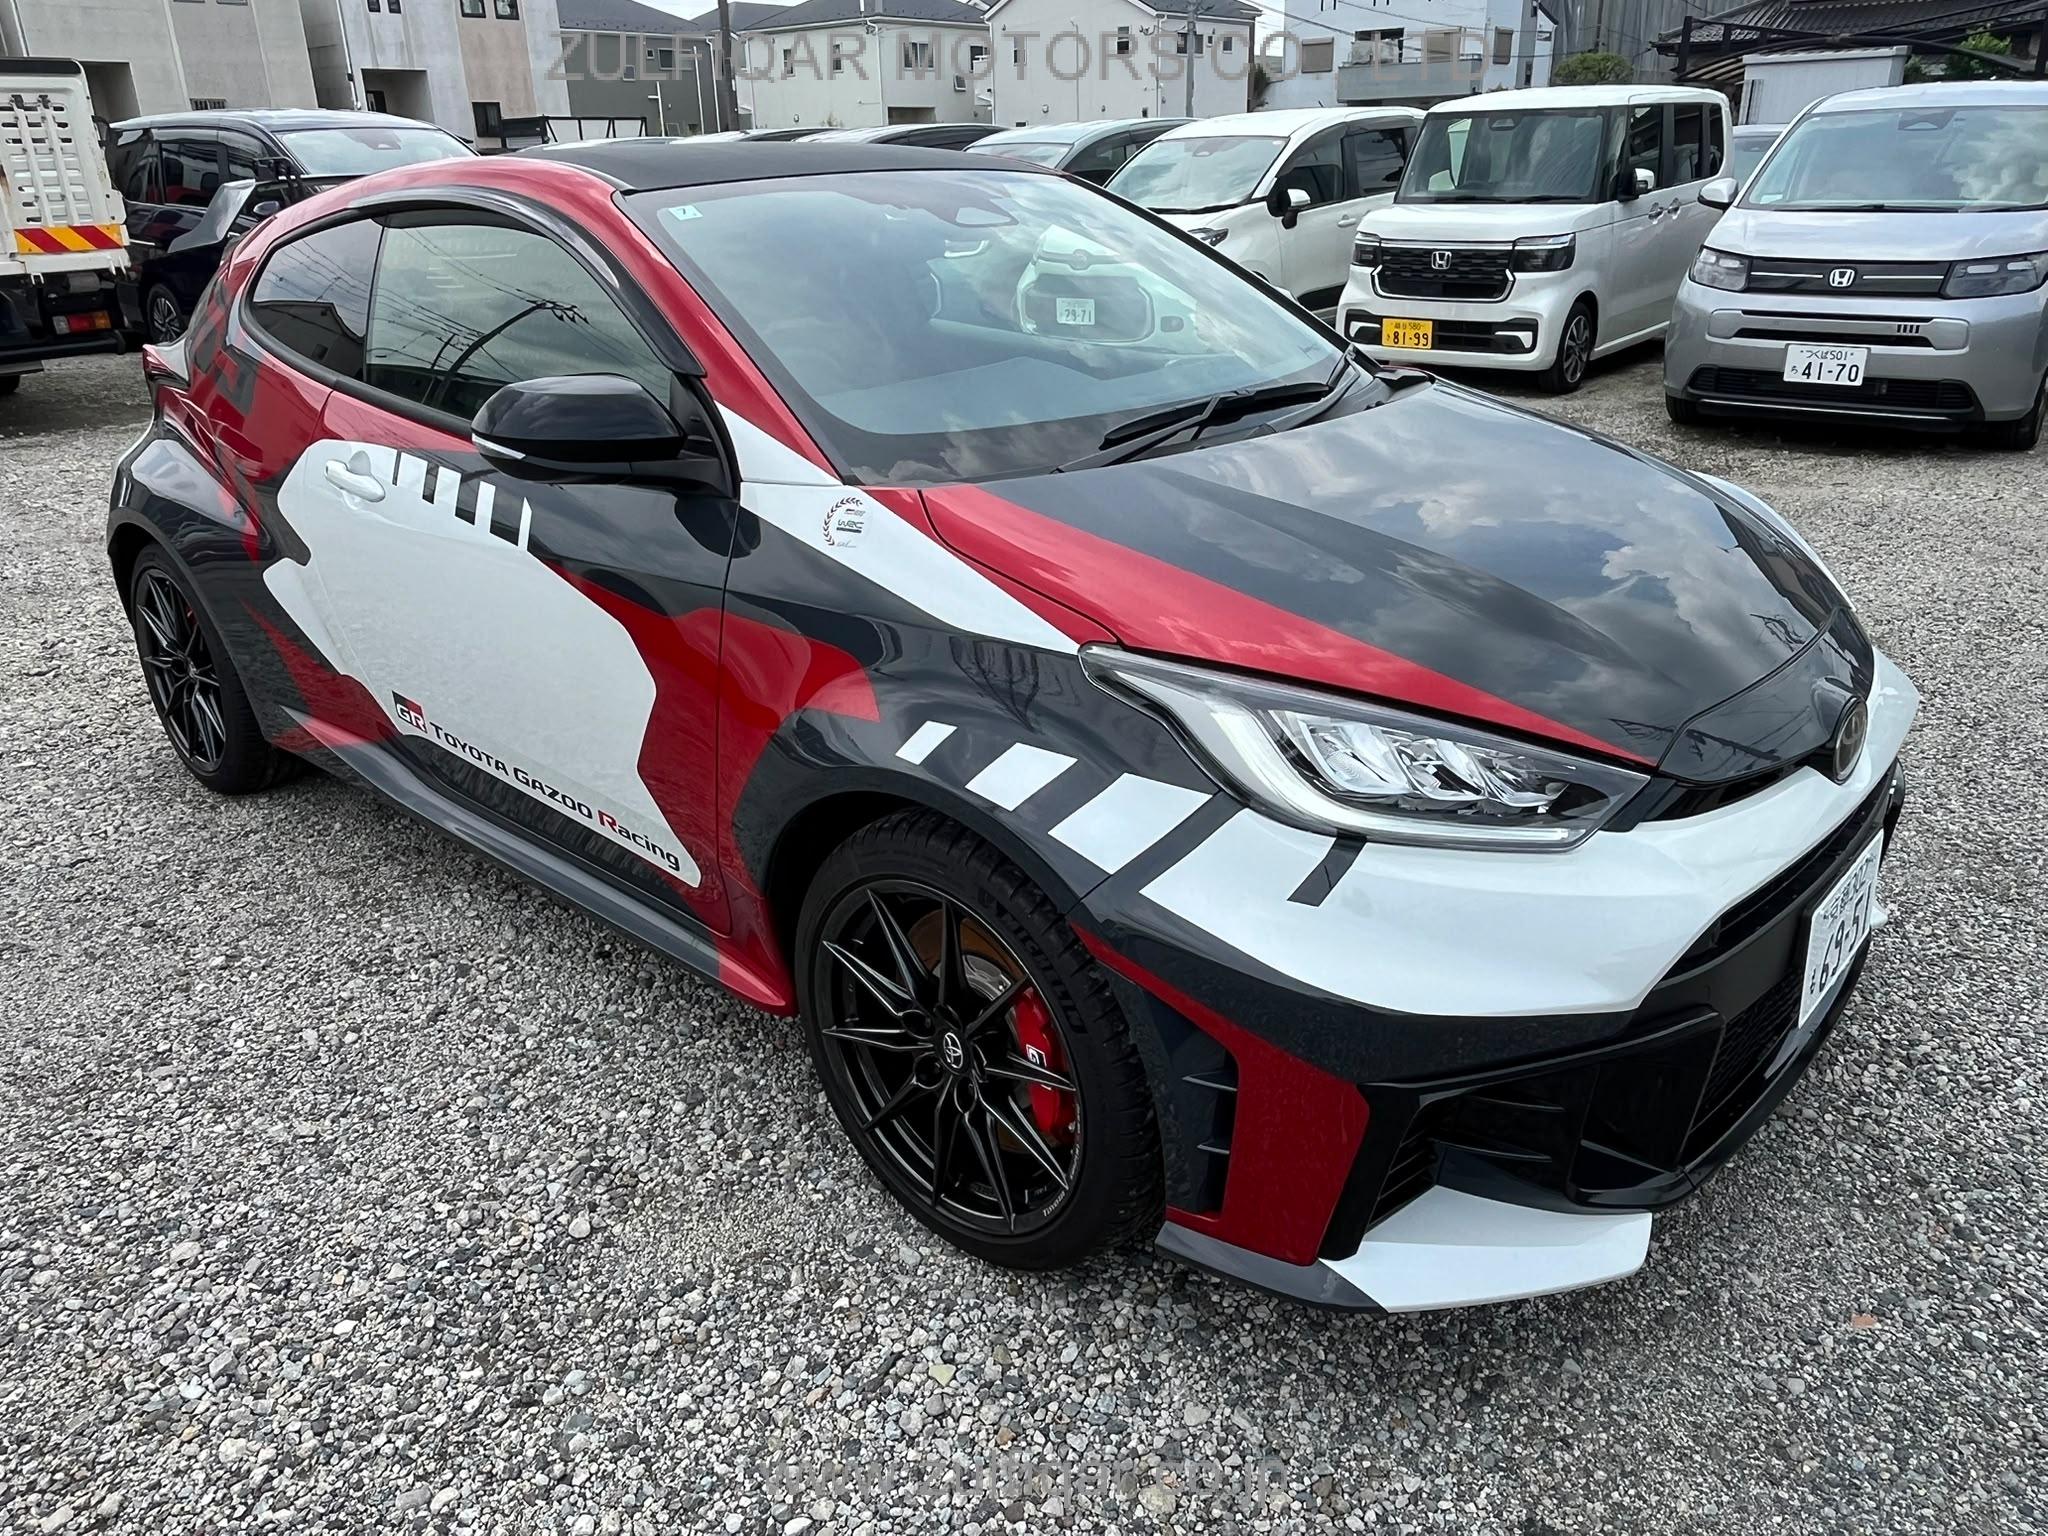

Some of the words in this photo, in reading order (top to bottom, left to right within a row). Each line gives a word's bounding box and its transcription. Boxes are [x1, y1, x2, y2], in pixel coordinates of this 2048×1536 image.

[1801, 361, 1860, 383] 41-70
[395, 702, 427, 733] GR
[429, 721, 510, 777] TOYOTA
[513, 766, 594, 820] GAZOO
[597, 809, 681, 872] Racing
[1818, 879, 1872, 993] 69-51
